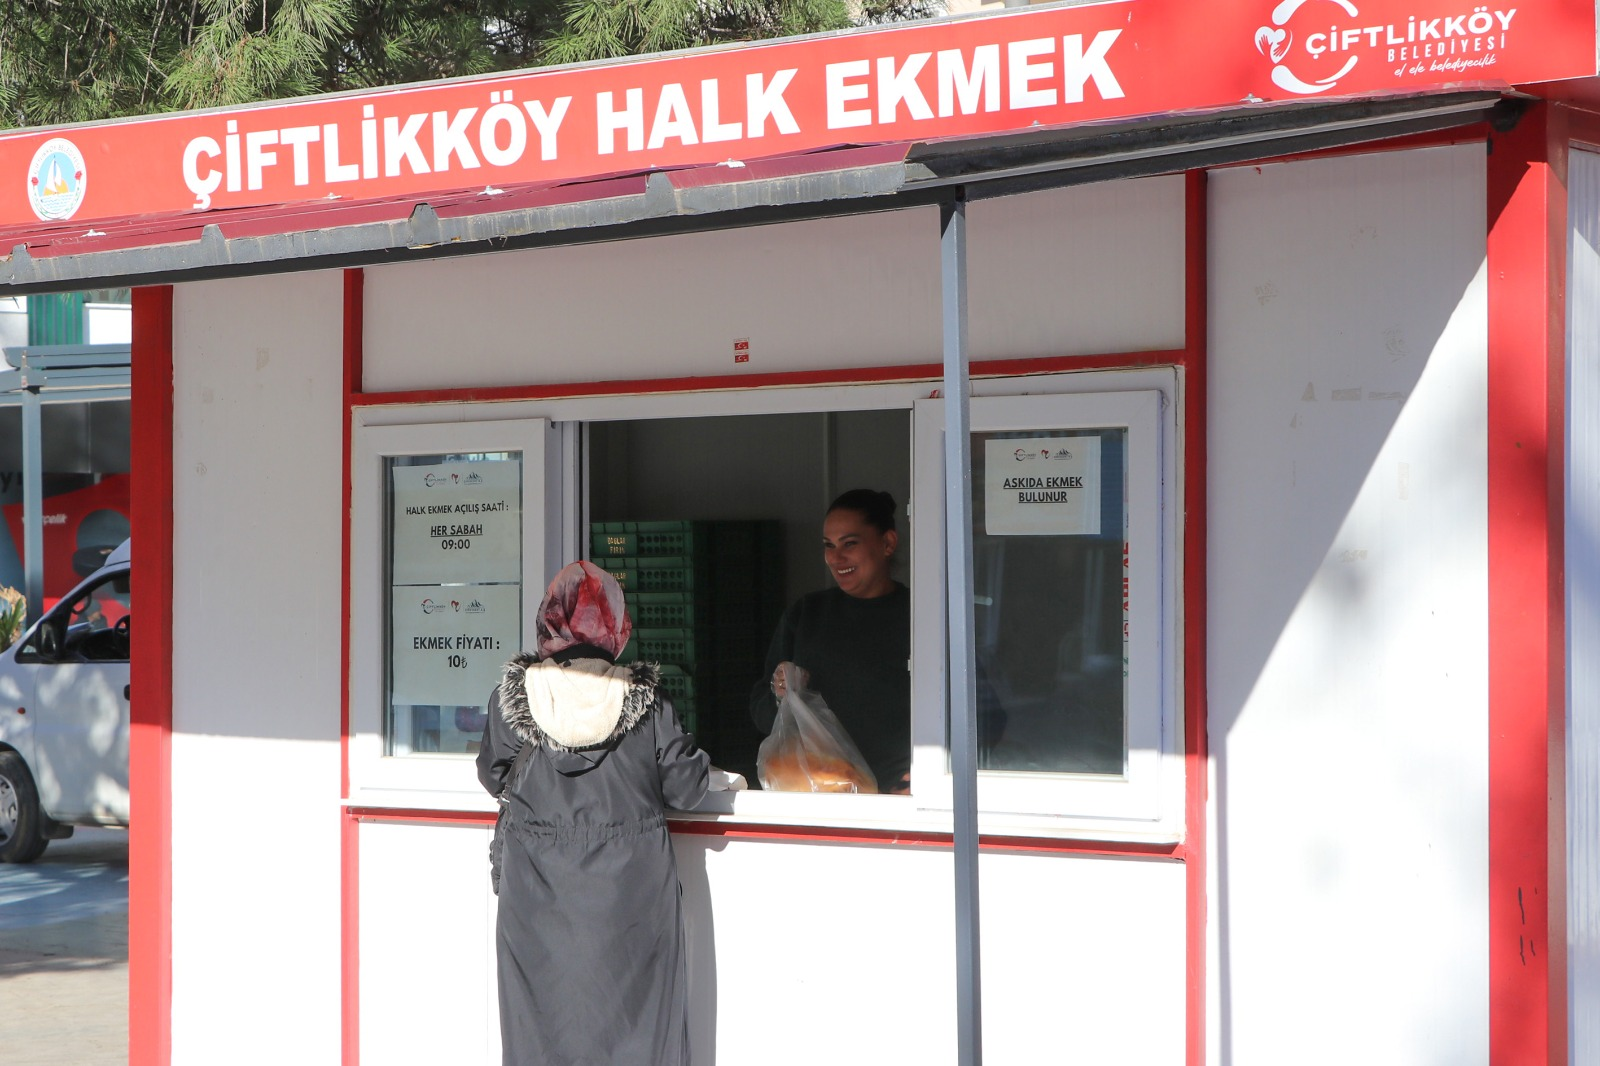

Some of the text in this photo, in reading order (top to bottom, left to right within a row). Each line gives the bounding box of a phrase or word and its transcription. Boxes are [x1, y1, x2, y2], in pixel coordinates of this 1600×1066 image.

[1305, 5, 1517, 60] ÇİFTLİKKÖY
[1387, 32, 1505, 62] BELEDİYESİ
[1394, 63, 1407, 77] el
[1429, 53, 1497, 72] belediyecilik
[182, 28, 1126, 210] ÇİFTLİKKÖY HALK EKMEK
[1003, 476, 1083, 488] ASKIDA EKMEK
[1018, 491, 1068, 502] BULUNUR
[406, 506, 426, 515] HALK
[428, 505, 453, 514] EKMEK
[454, 504, 480, 515] AÇILIŞ
[430, 524, 483, 536] HER SABAH
[441, 539, 471, 550] 09:00
[413, 636, 453, 650] EKMEK
